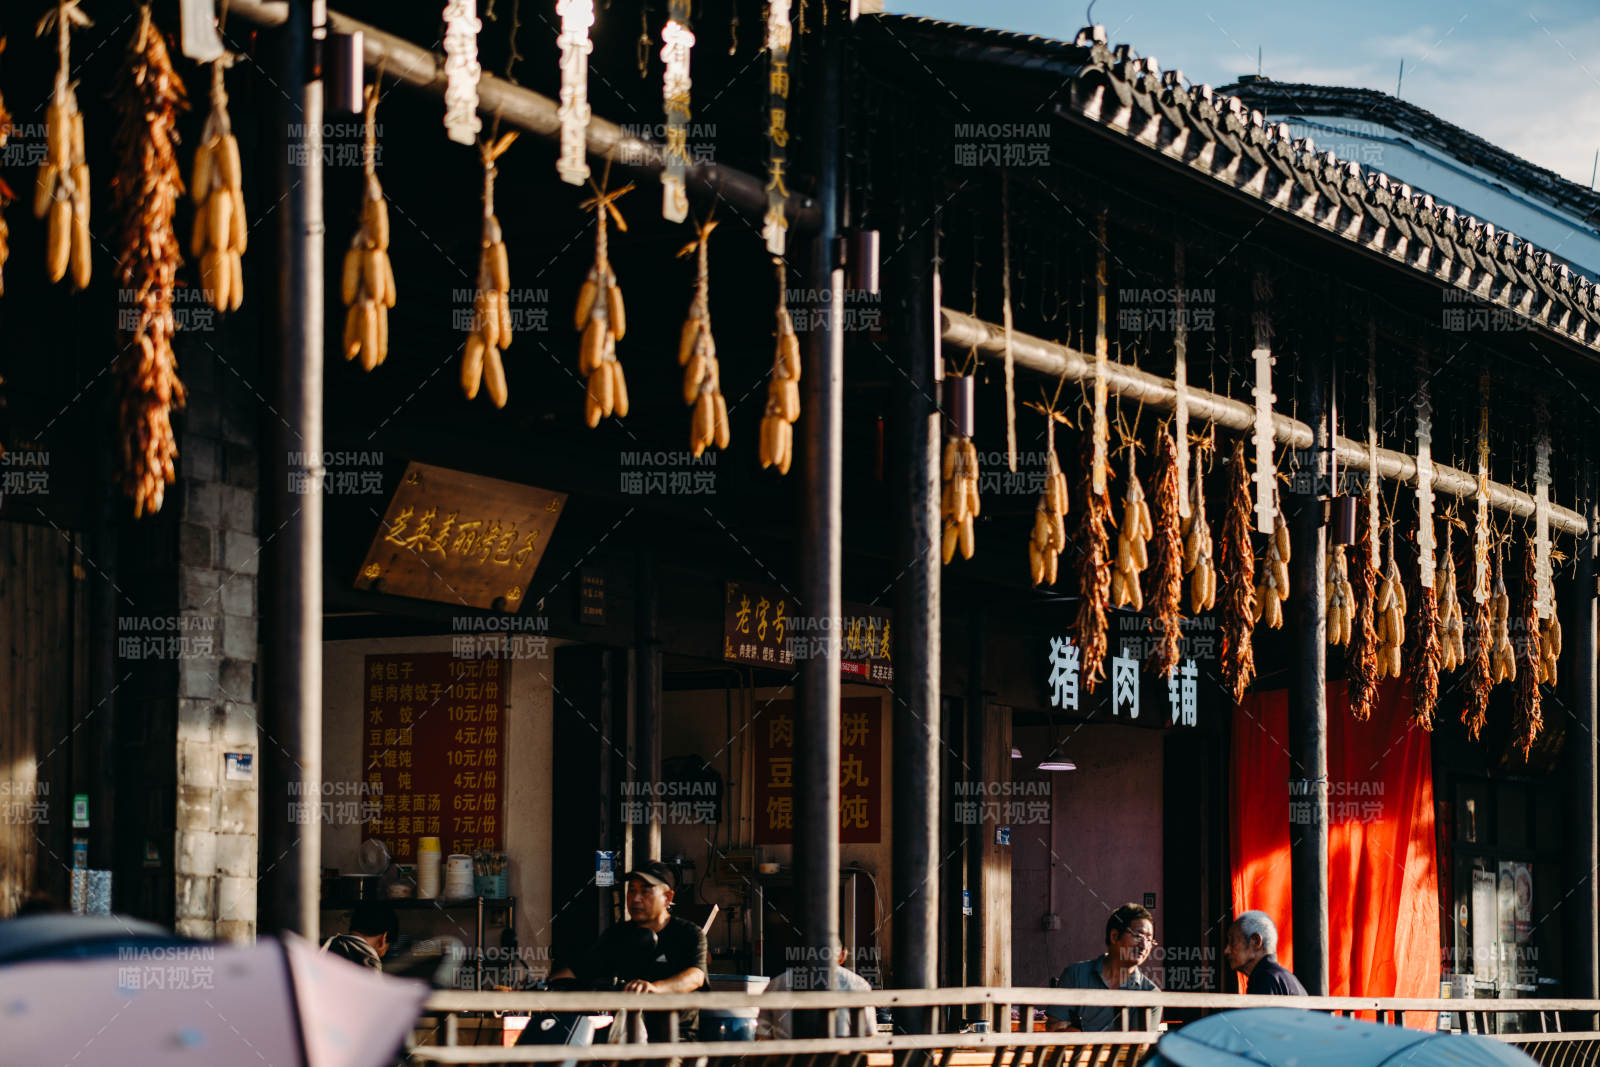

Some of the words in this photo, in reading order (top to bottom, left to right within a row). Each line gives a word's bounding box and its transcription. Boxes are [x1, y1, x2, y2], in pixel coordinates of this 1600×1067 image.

[735, 593, 787, 644] 老字号
[369, 661, 415, 680] 烤包子
[448, 660, 499, 678] 10元/份
[1048, 636, 1199, 728] 猪肉铺
[369, 683, 443, 703] 鲜肉烤饺子
[449, 682, 499, 700] 10元/份
[447, 704, 498, 722] 10元/份
[454, 726, 498, 744] 4元/份
[368, 749, 413, 768] 大馄饨
[446, 748, 498, 767] 10元/份
[453, 770, 497, 789] 4元/份
[453, 793, 497, 811] 6元/份
[452, 815, 496, 833] 7元/份
